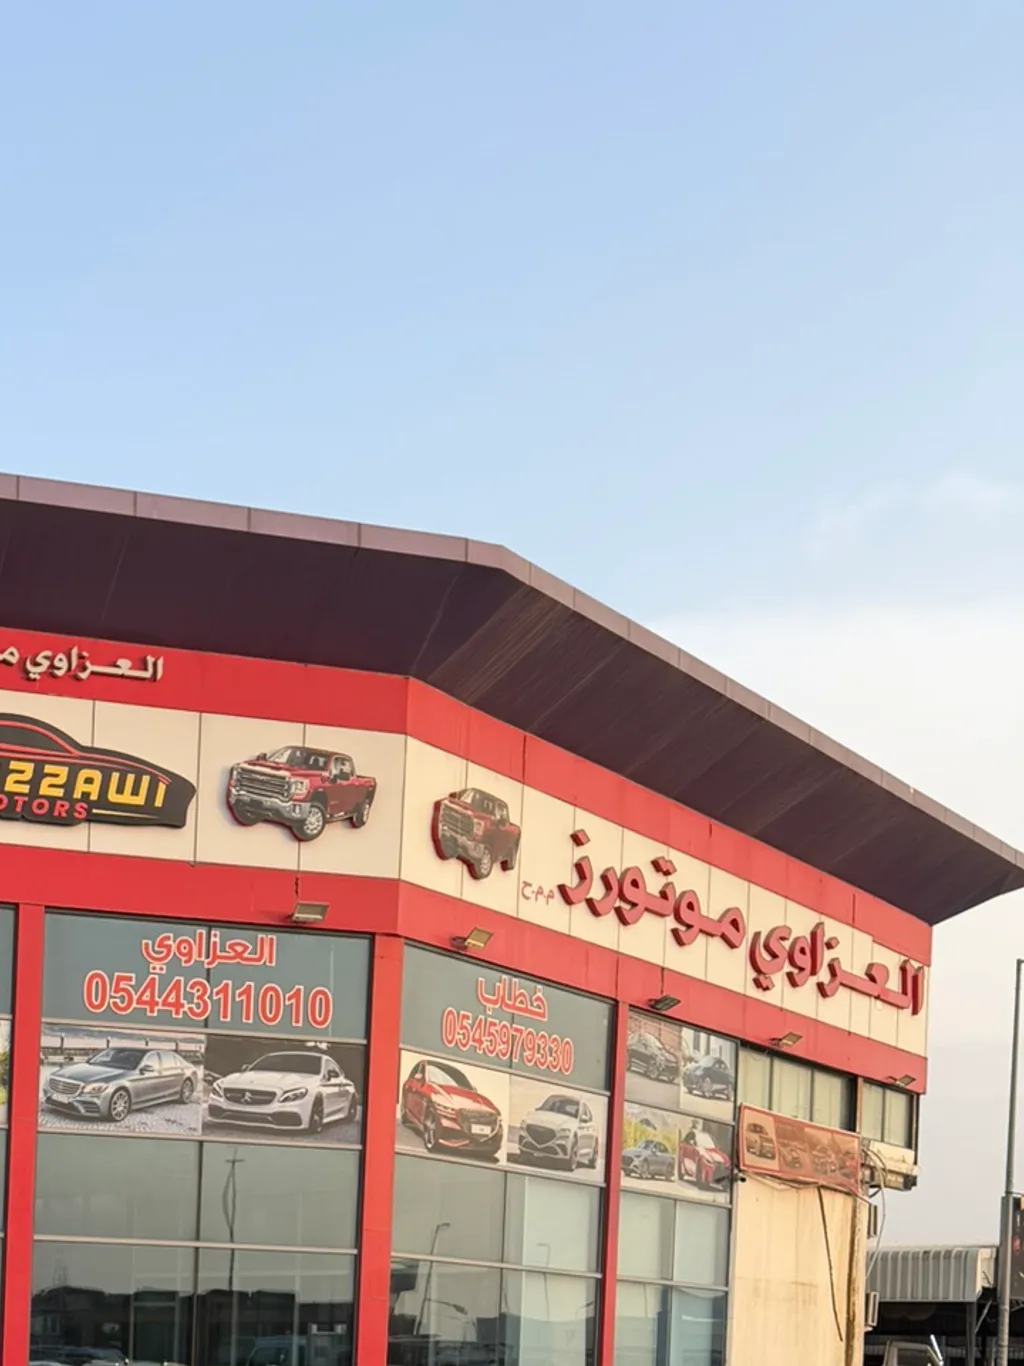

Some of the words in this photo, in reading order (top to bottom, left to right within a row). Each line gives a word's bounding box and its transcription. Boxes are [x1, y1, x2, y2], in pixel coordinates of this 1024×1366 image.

[25, 647, 165, 681] العزاوي
[557, 828, 746, 949] موتورز
[142, 929, 277, 974] العزاوي
[749, 921, 925, 1016] العزاوي
[83, 970, 333, 1029] 0544311010
[477, 975, 549, 1022] خطاب
[442, 1007, 575, 1075] 0545979330
